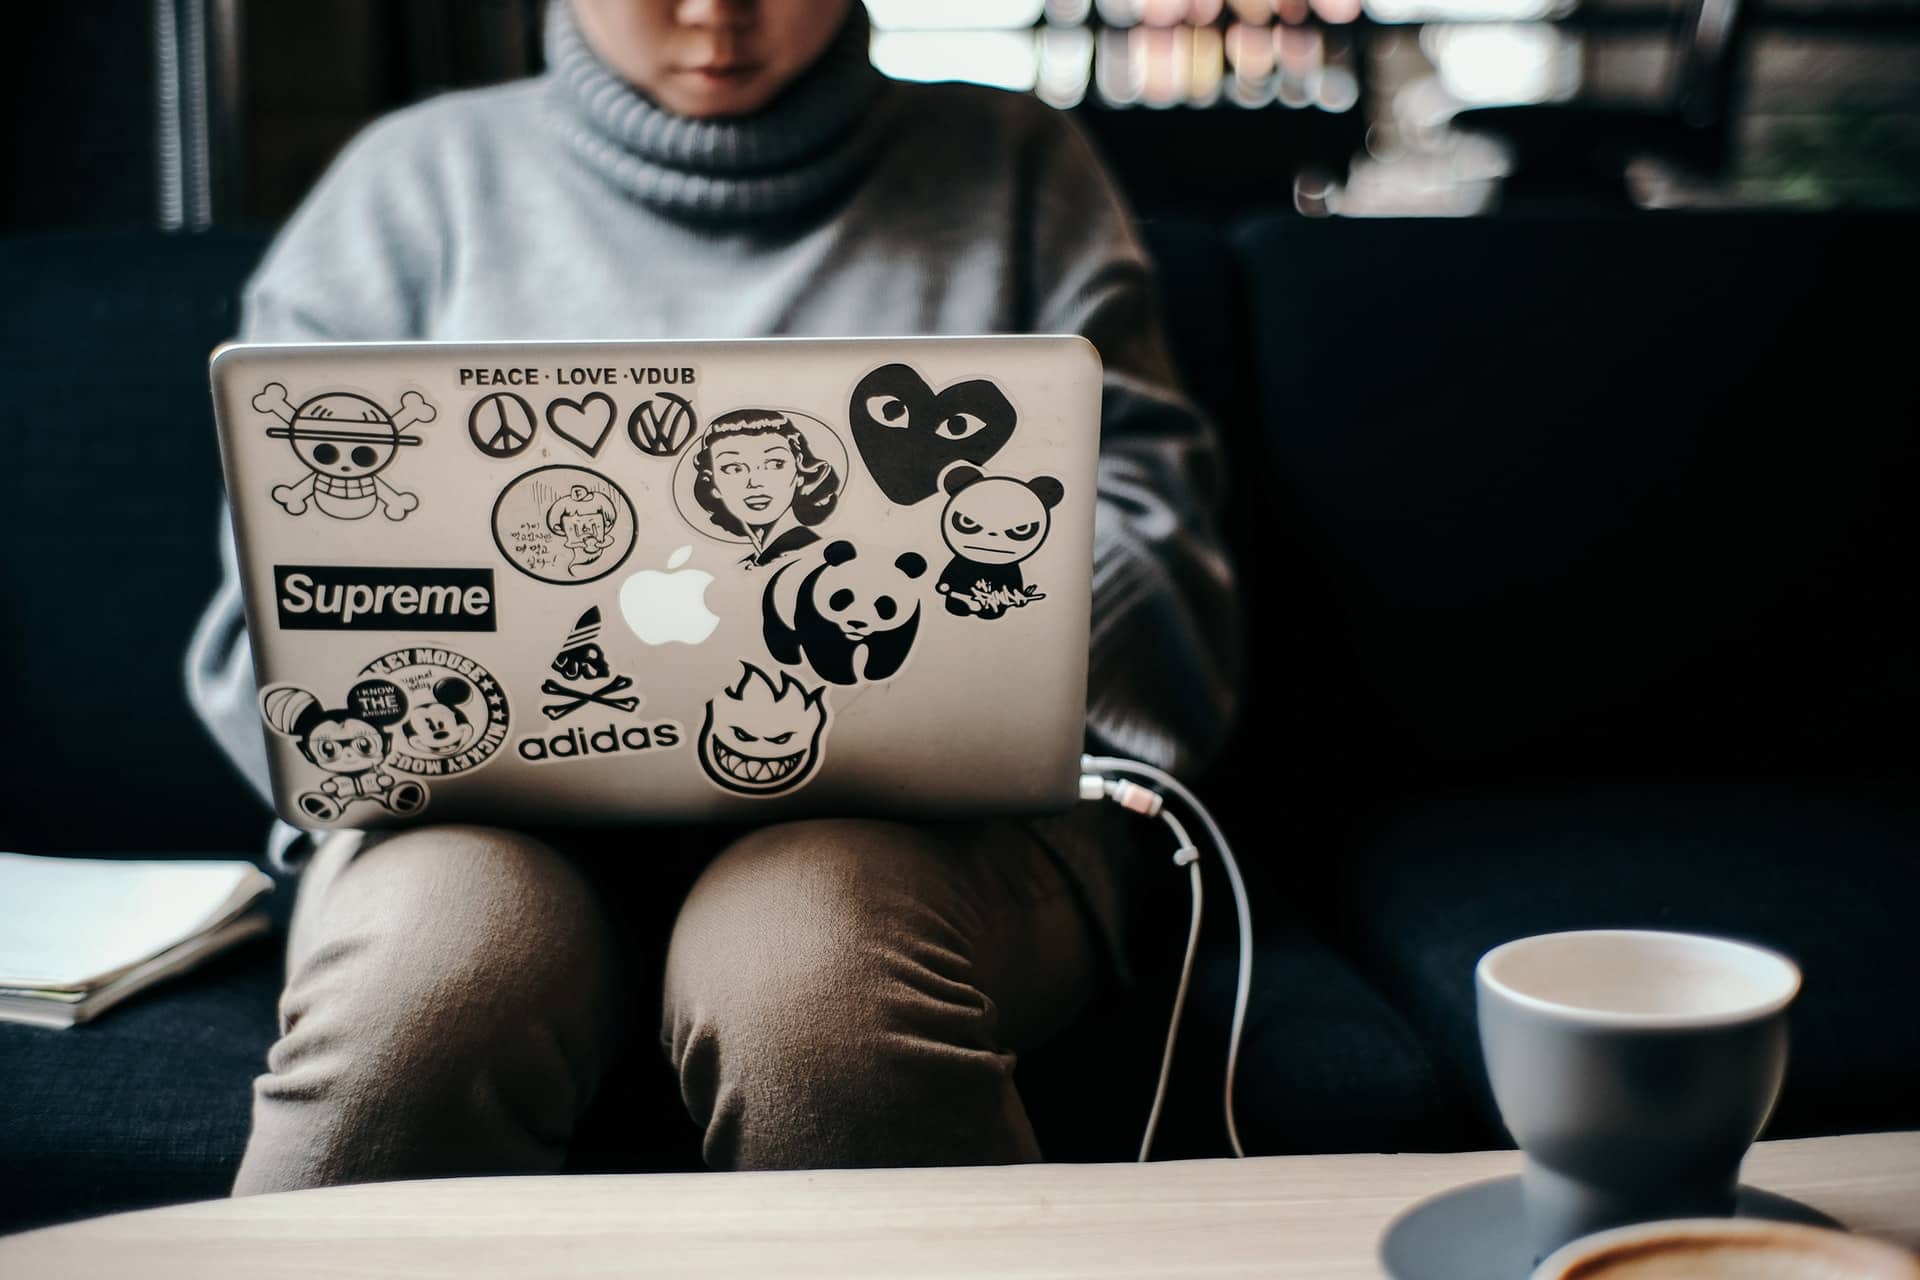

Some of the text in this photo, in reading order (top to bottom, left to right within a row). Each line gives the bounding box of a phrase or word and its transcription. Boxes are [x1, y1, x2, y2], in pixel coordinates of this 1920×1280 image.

[459, 367, 696, 386] PEACE LOVE VDUB
[574, 489, 582, 499] F
[282, 573, 491, 624] Supreme
[415, 649, 488, 682] MOUSE
[358, 695, 399, 710] THE
[361, 686, 395, 697] KNOW
[447, 722, 507, 774] MICKEY
[518, 723, 680, 761] adidas
